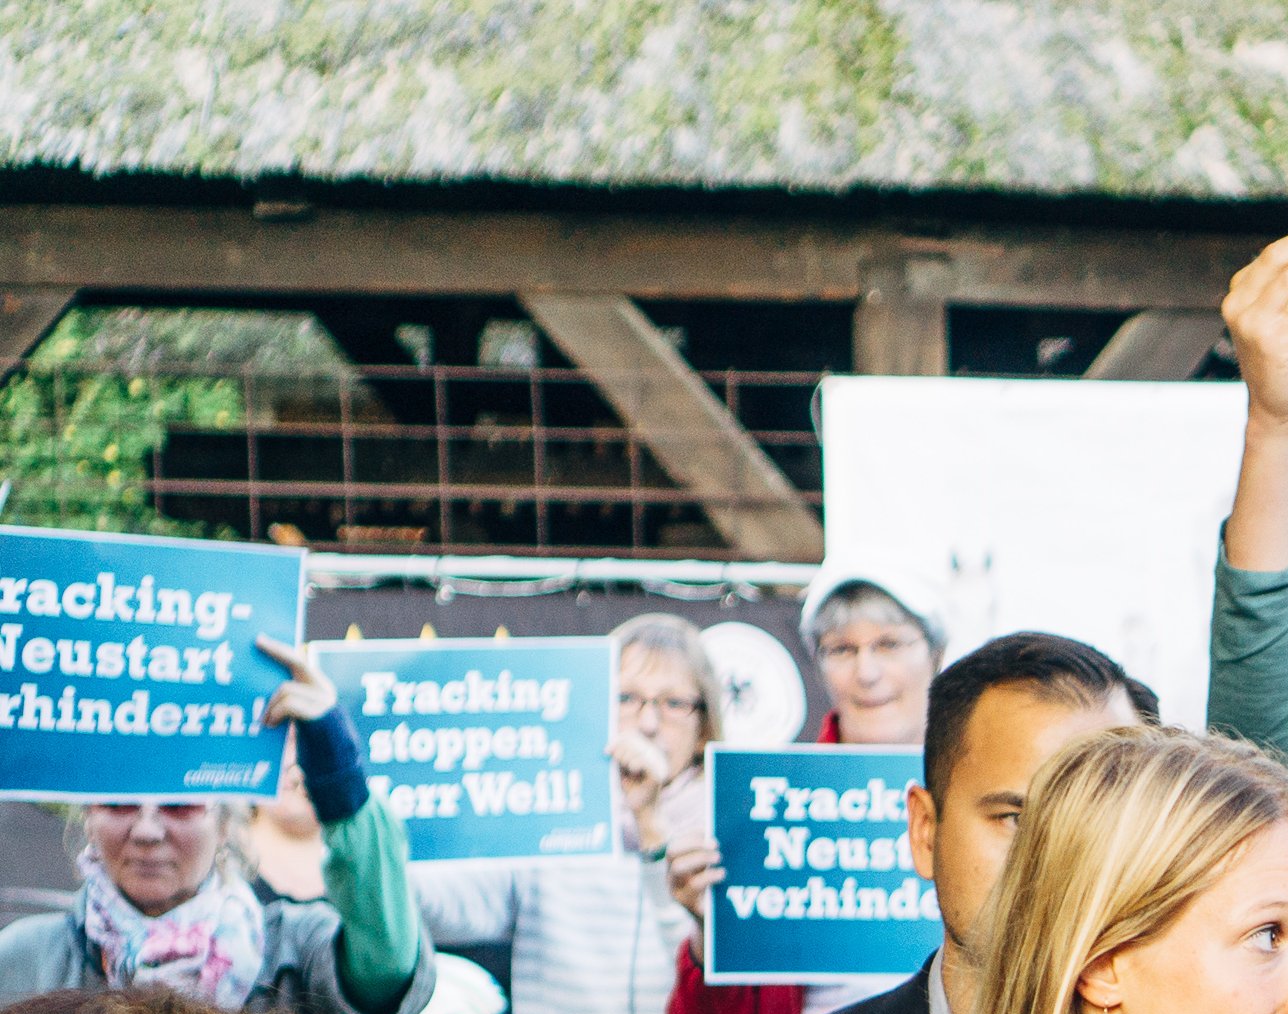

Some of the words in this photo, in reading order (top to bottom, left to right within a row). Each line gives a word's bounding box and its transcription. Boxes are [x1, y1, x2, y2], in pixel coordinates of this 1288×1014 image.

[0, 572, 253, 642] racking-
[0, 682, 267, 737] rhindern!
[361, 670, 572, 722] Fracking
[369, 721, 564, 772] stoppen,
[462, 769, 583, 817] Weil!
[750, 776, 918, 822] Frack
[764, 826, 915, 871] Neust
[726, 876, 943, 920] verhinde
